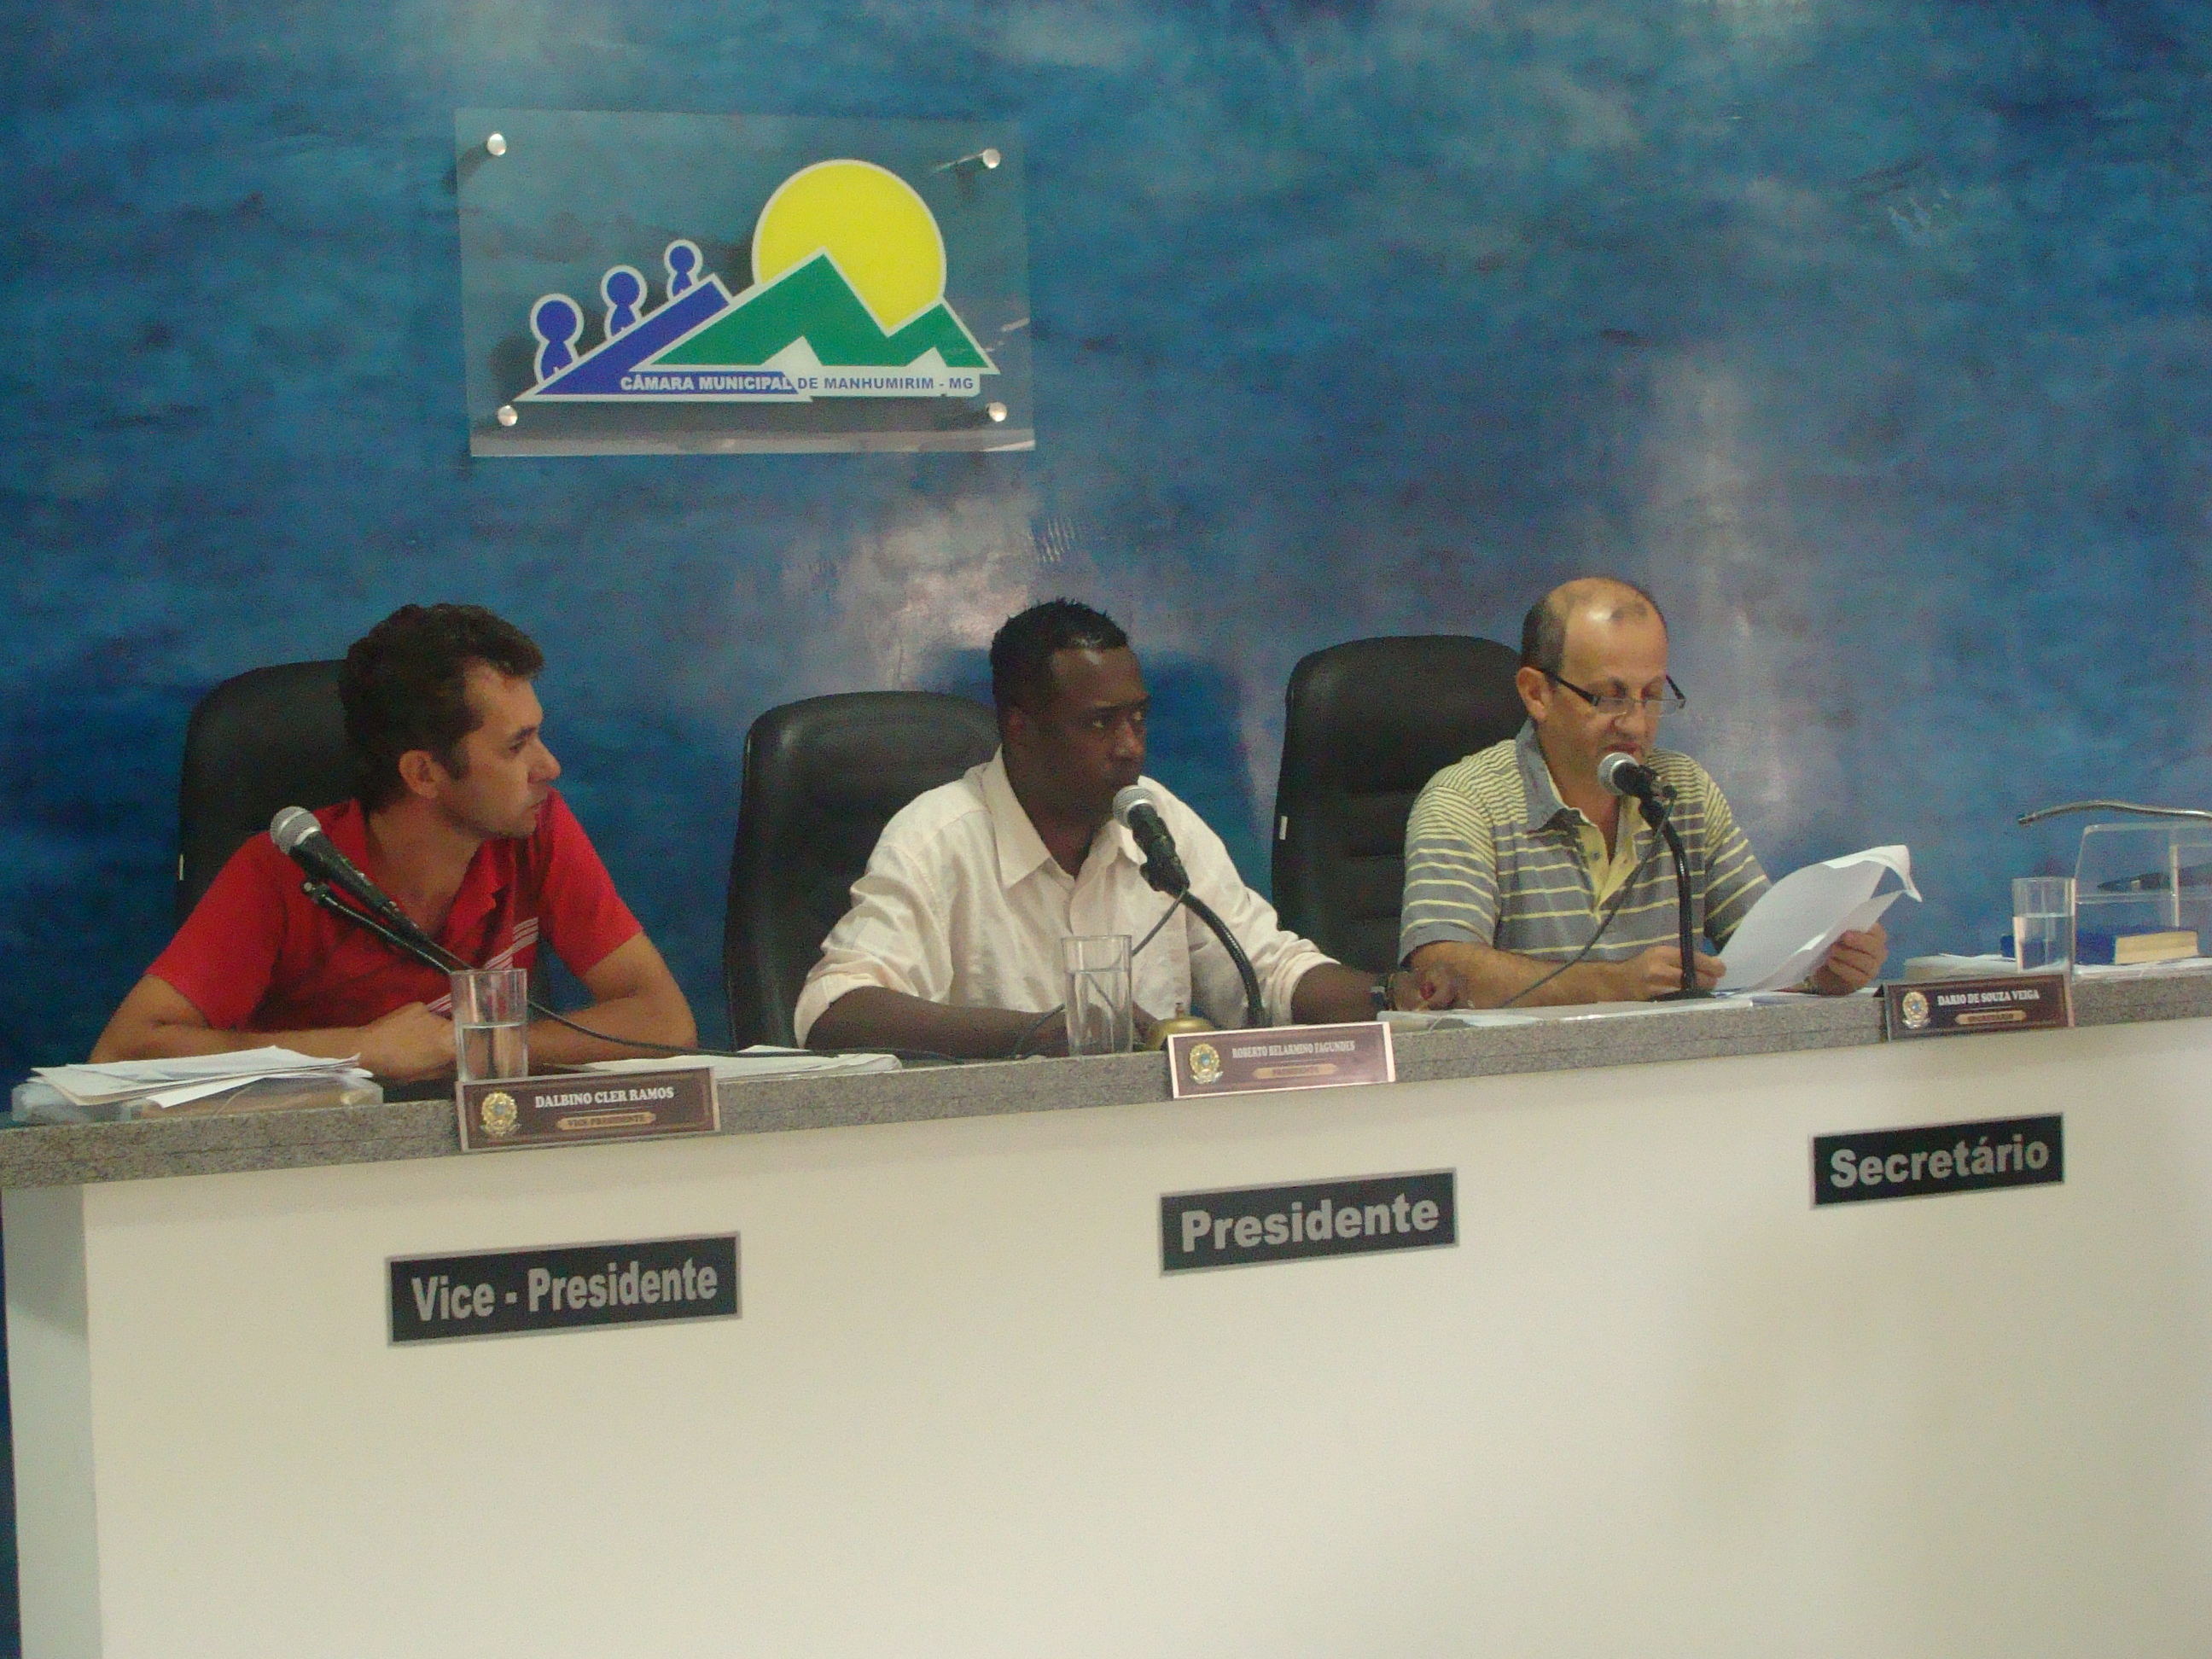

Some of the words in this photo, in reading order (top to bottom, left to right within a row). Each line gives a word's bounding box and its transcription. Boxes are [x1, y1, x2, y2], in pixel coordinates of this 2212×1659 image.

[620, 374, 694, 391] CÂMARA
[698, 373, 794, 390] MUNICIPAL
[798, 377, 818, 389] DE
[824, 377, 935, 389] MANHUMIRIM
[949, 377, 974, 389] MG
[1968, 993, 1979, 1004] DE
[1981, 991, 2011, 1002] SOUZA
[535, 1092, 591, 1108] DALBINO
[594, 1090, 627, 1103] CLER
[630, 1086, 674, 1101] RAMOS
[1831, 1133, 2049, 1188] Secretário
[1181, 1193, 1440, 1252] Presidente
[412, 1275, 496, 1321] Vice
[527, 1258, 718, 1313] Presidente
